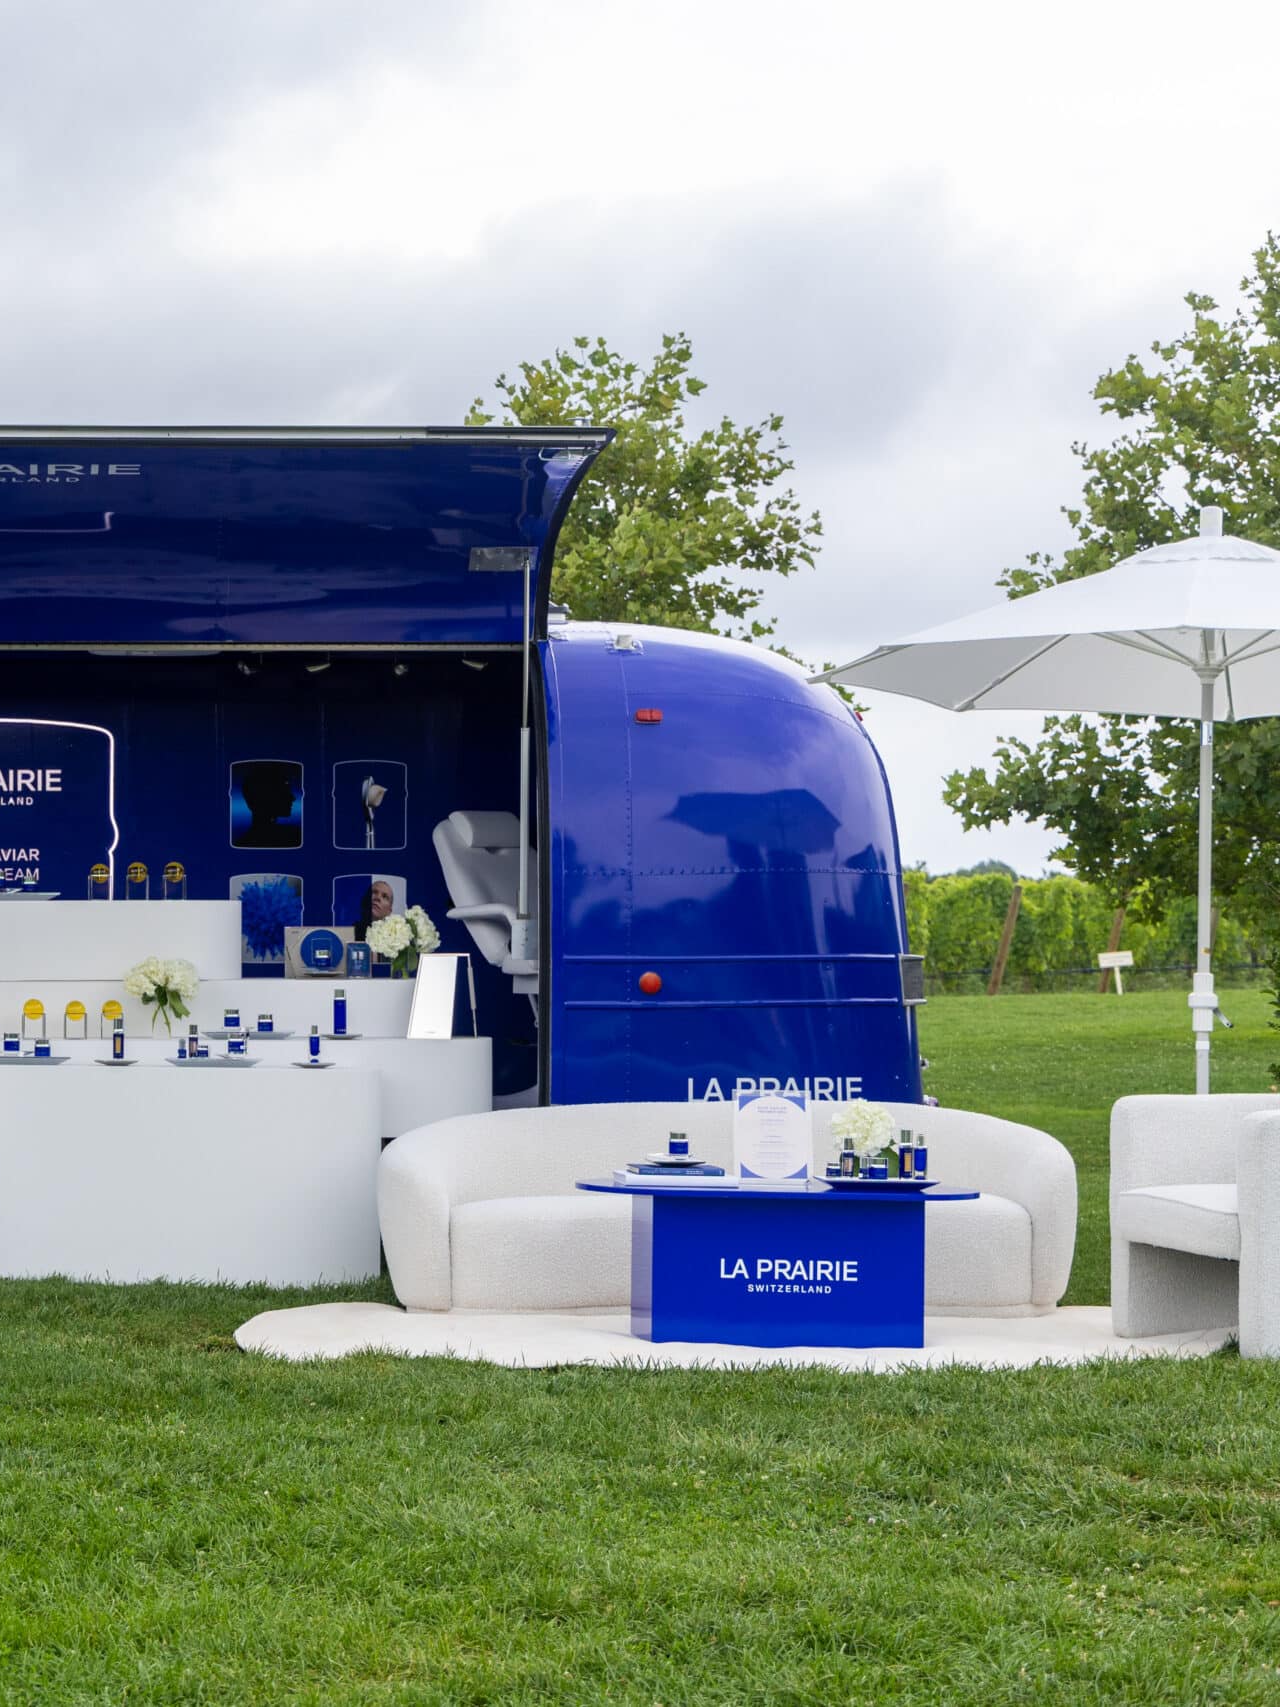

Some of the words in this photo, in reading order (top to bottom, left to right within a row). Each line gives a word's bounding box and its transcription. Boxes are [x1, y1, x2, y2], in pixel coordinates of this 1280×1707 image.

[687, 1077, 725, 1101] LA
[720, 1258, 750, 1280] LA
[756, 1258, 858, 1282] PRAIRIE
[747, 1283, 833, 1294] SWITZERLAND
